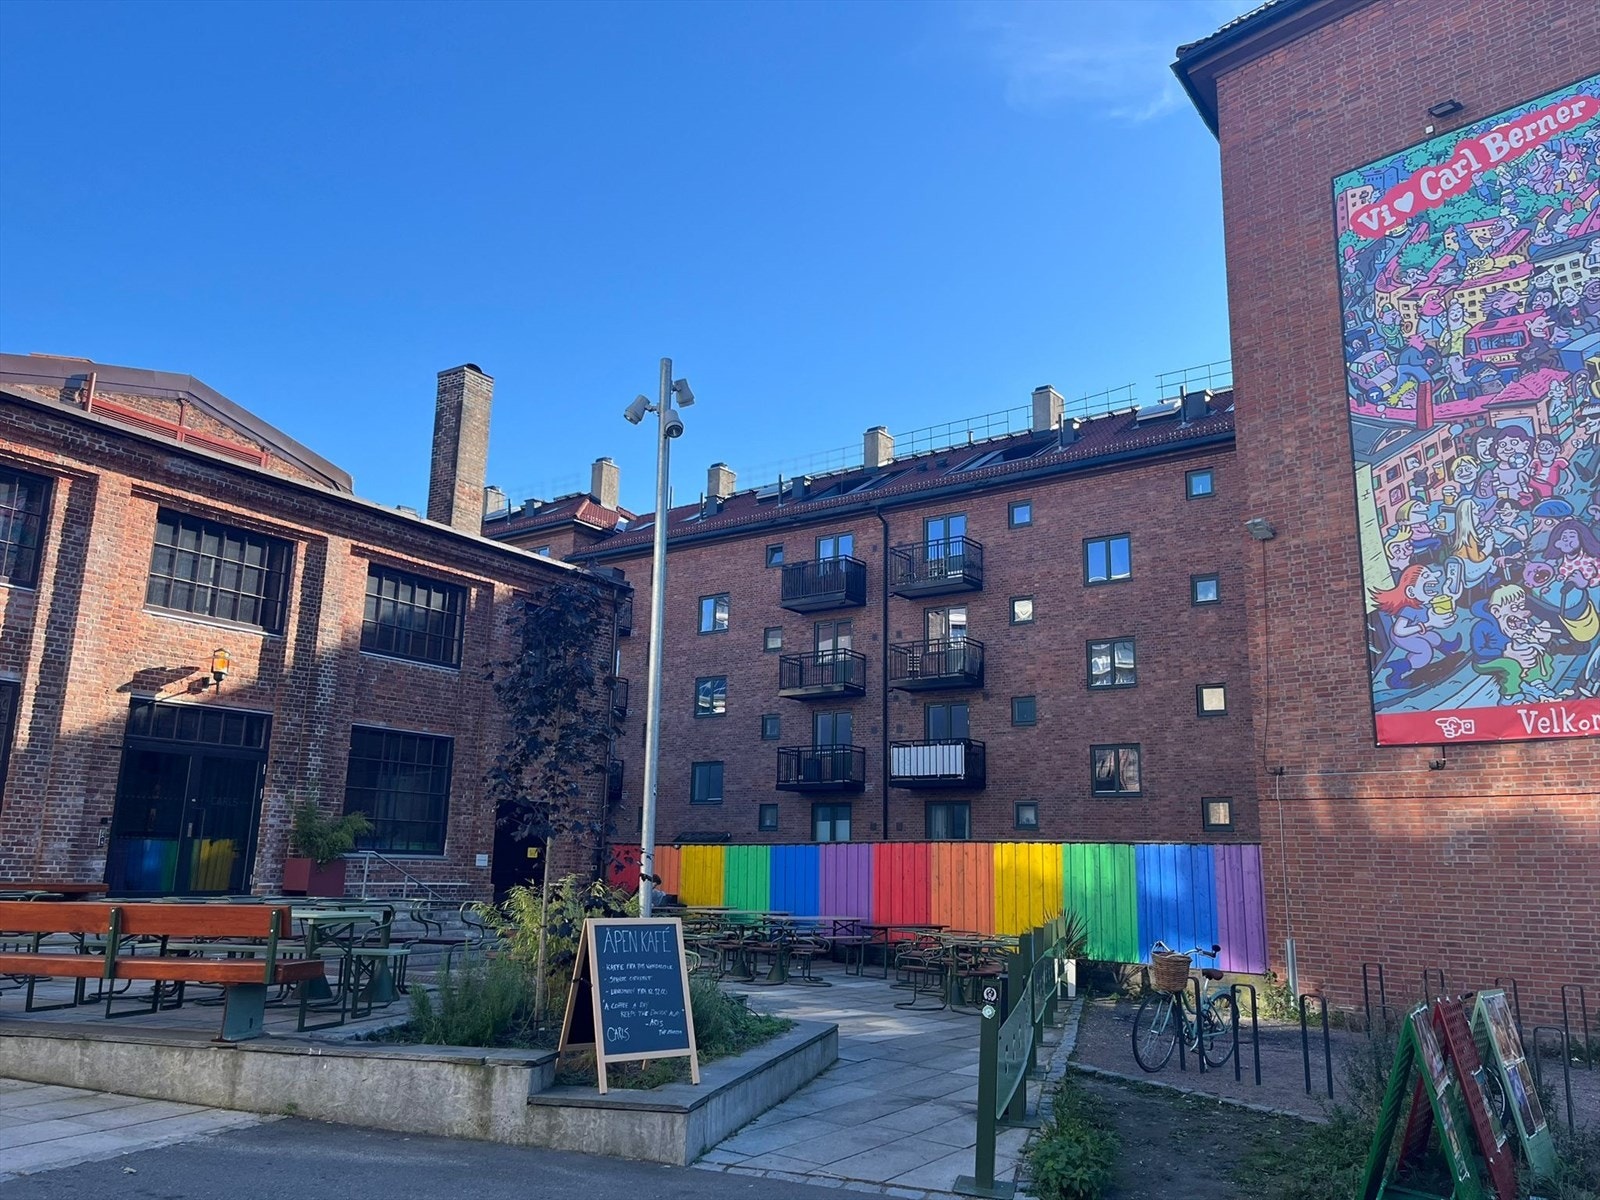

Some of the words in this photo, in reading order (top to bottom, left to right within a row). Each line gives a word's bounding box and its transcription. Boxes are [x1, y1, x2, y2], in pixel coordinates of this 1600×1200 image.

[1357, 200, 1396, 231] Vi
[1419, 149, 1483, 201] Carl
[1479, 99, 1587, 164] Berner
[603, 926, 638, 953] ÅPEN
[640, 926, 672, 953] KAFÉ
[607, 1026, 631, 1042] CARLS
